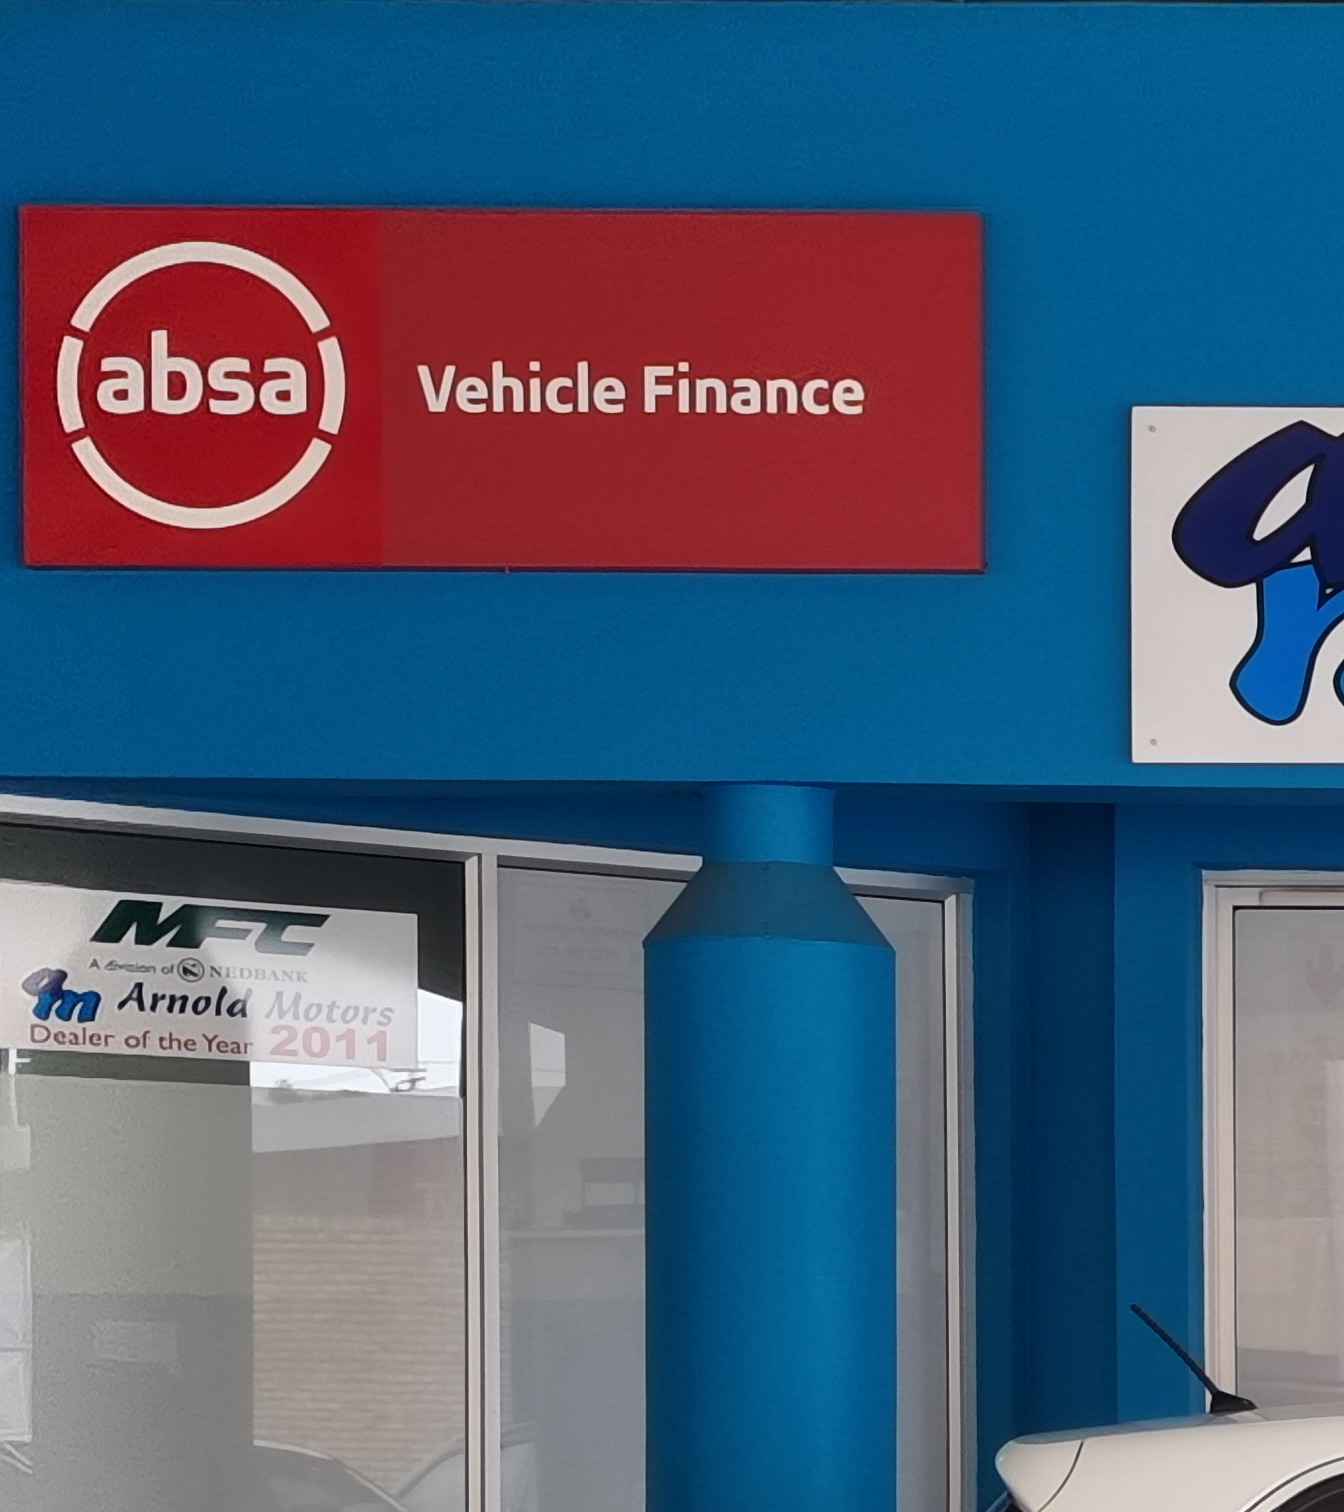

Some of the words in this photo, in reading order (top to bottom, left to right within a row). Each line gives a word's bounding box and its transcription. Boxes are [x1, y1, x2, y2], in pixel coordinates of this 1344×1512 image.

[97, 330, 307, 415] absa
[417, 361, 625, 414] Vehicle
[644, 361, 864, 415] Finance
[90, 899, 332, 956] MFC
[89, 958, 101, 970] A
[160, 963, 175, 975] of
[209, 965, 309, 984] NEDBANK
[117, 981, 249, 1018] Arnold
[264, 990, 395, 1027] Motors
[30, 1023, 115, 1048] Dealer
[124, 1030, 151, 1051] of
[158, 1032, 197, 1053] the
[202, 1032, 254, 1056] Year
[269, 1024, 388, 1062] 2011
